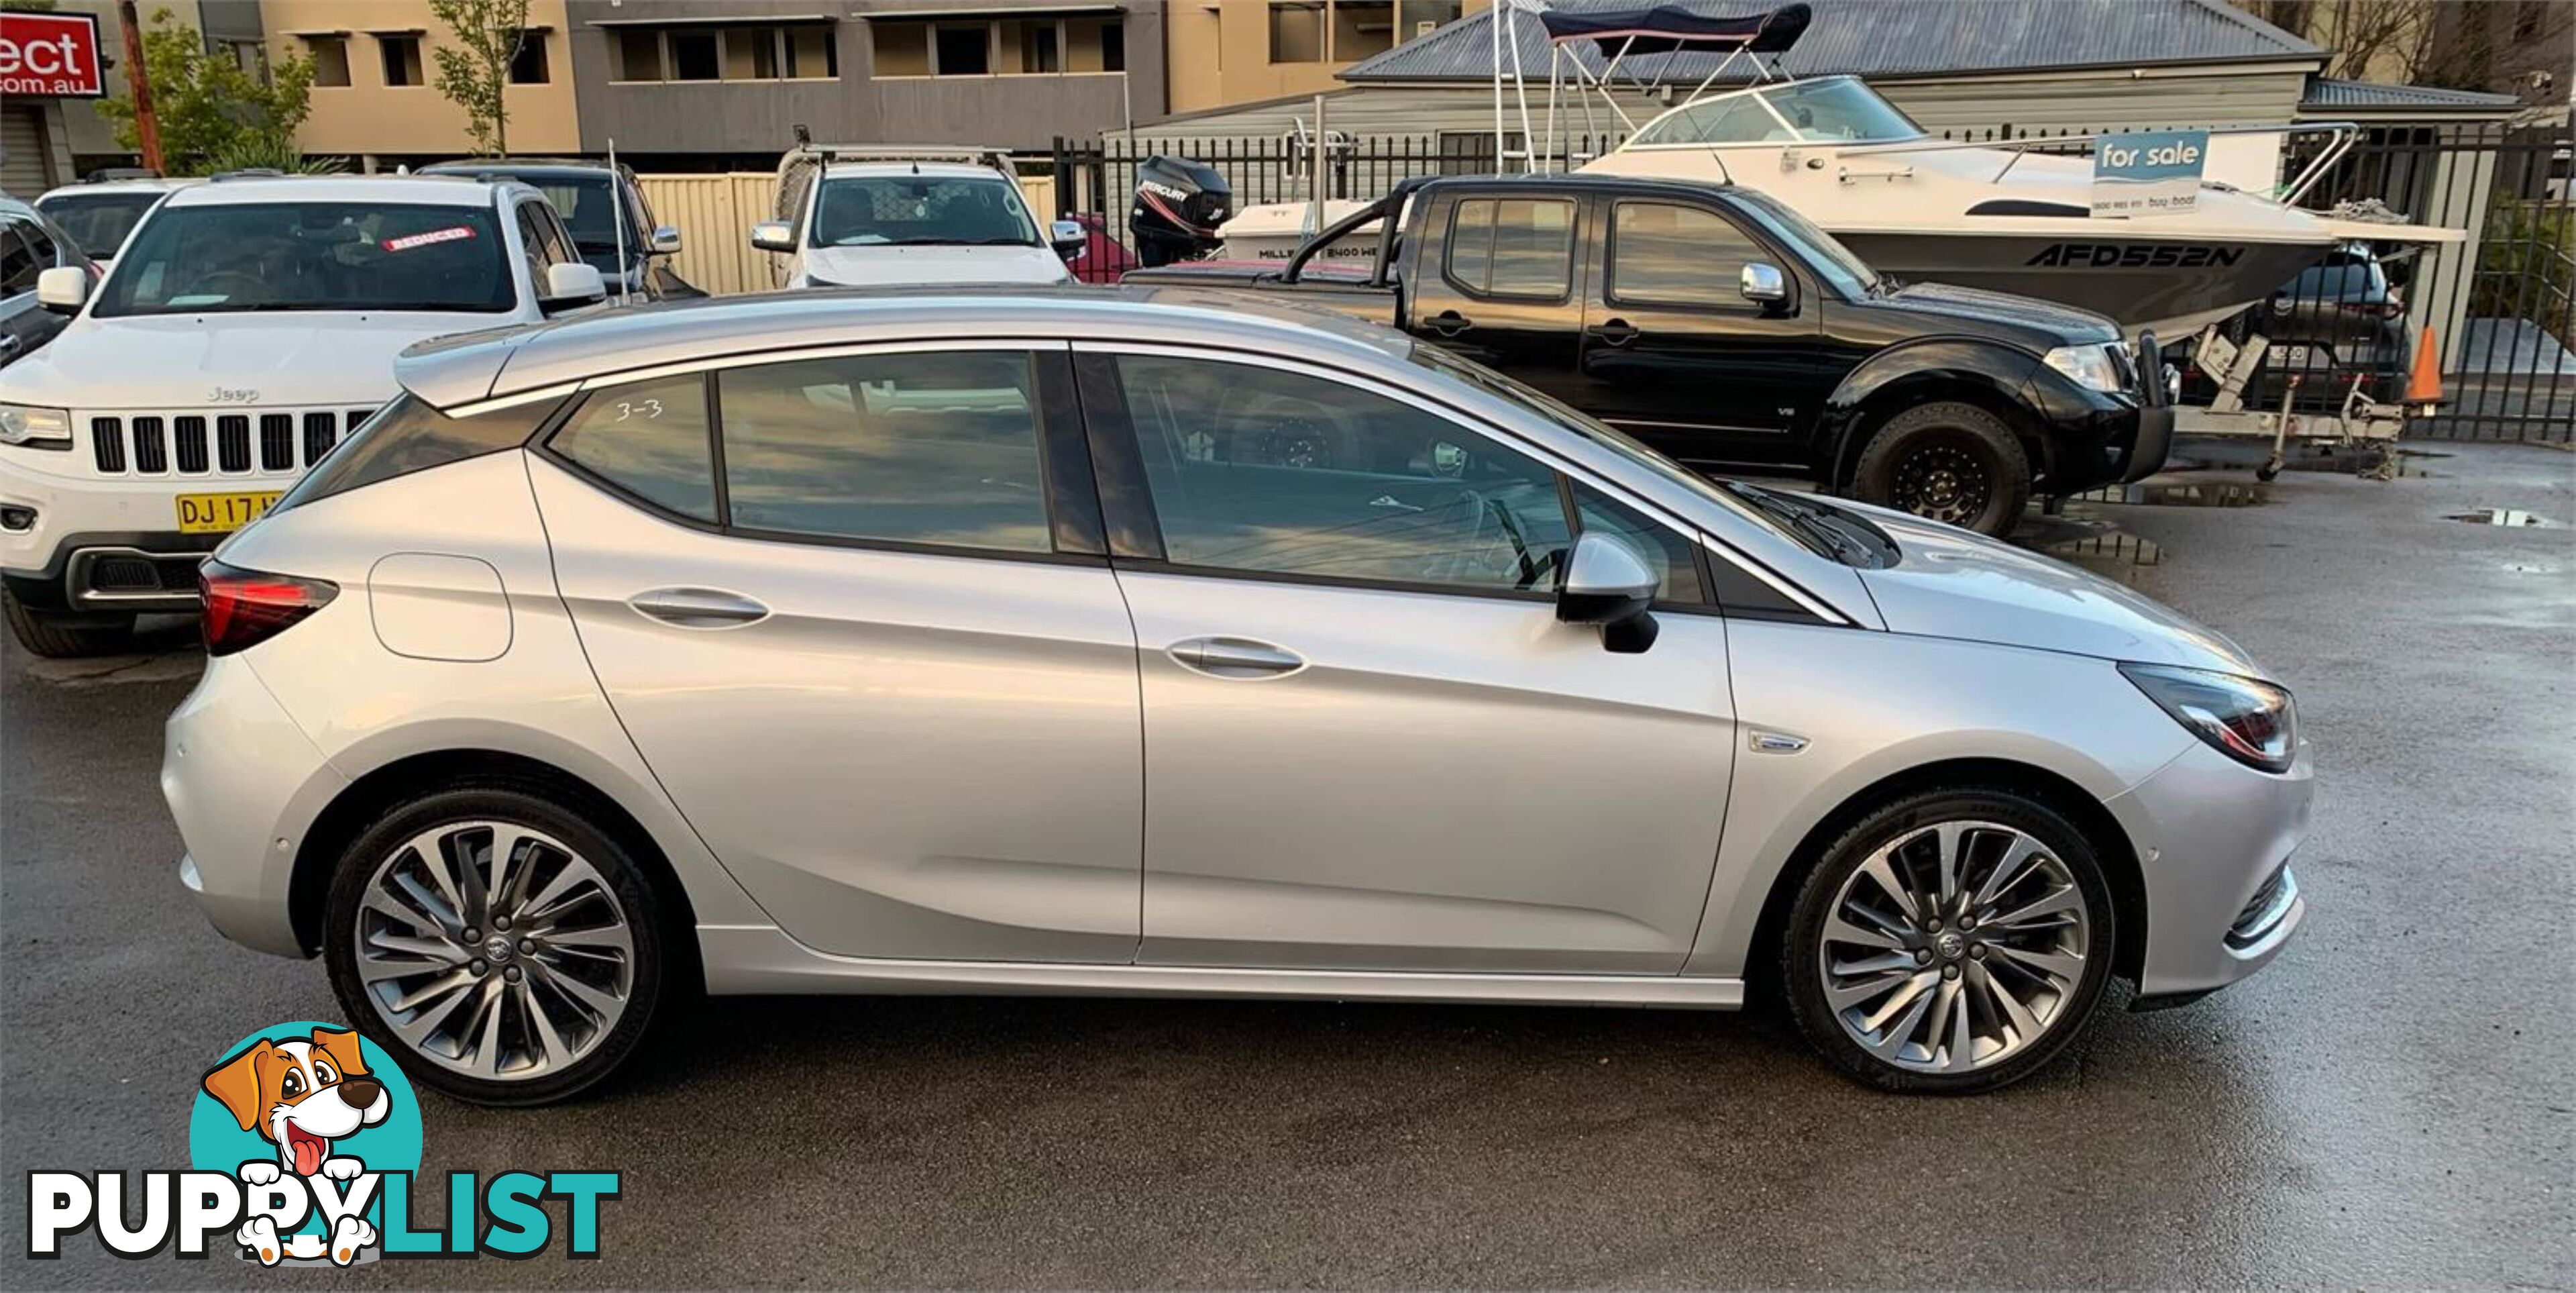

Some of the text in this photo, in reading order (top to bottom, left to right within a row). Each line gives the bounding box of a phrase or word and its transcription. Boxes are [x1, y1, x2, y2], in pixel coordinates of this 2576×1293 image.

[0, 78, 85, 93] om.au
[2102, 140, 2200, 168] for sale
[1142, 179, 1188, 202] MERCURY
[2024, 244, 2245, 268] AFD552N
[206, 386, 259, 404] Jeep
